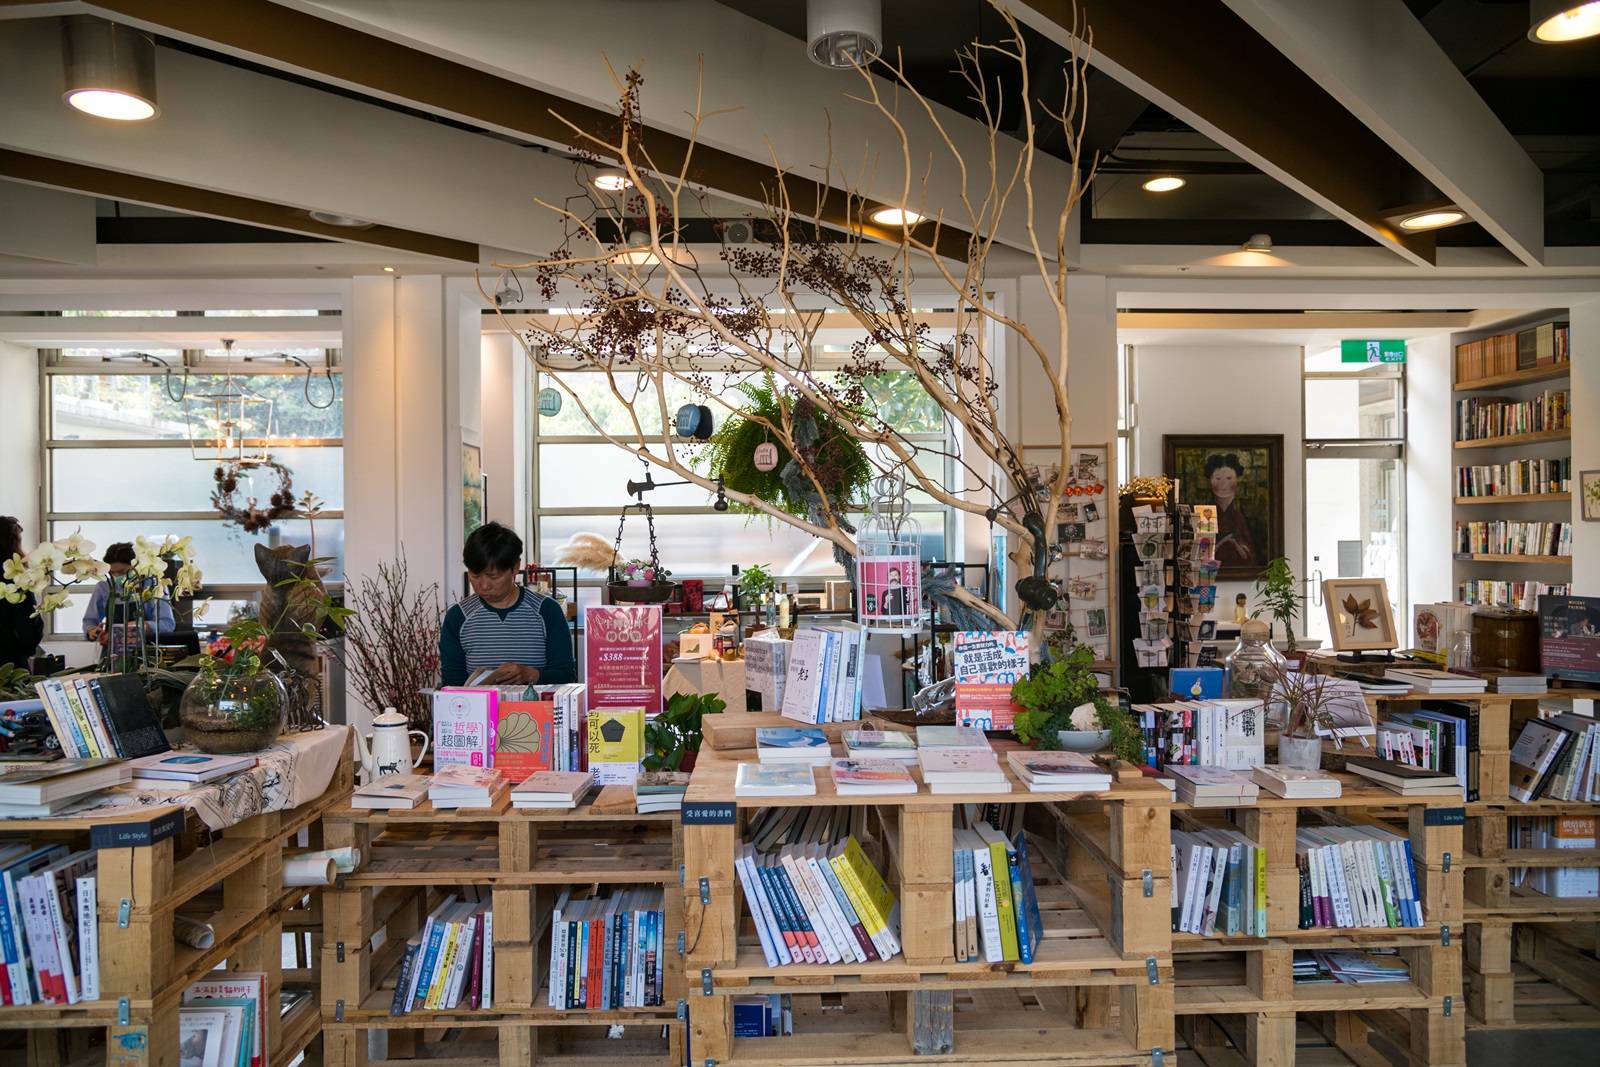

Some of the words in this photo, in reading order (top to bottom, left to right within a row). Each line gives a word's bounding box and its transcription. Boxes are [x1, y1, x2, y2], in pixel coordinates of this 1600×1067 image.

[603, 653, 623, 661] $388
[963, 650, 1002, 664] 就是活成
[960, 657, 1026, 675] 自己喜歡的樣子
[454, 722, 478, 735] 哲學
[442, 734, 478, 747] 超圖解
[1562, 820, 1594, 829] 烘焙新手
[132, 832, 147, 840] Style
